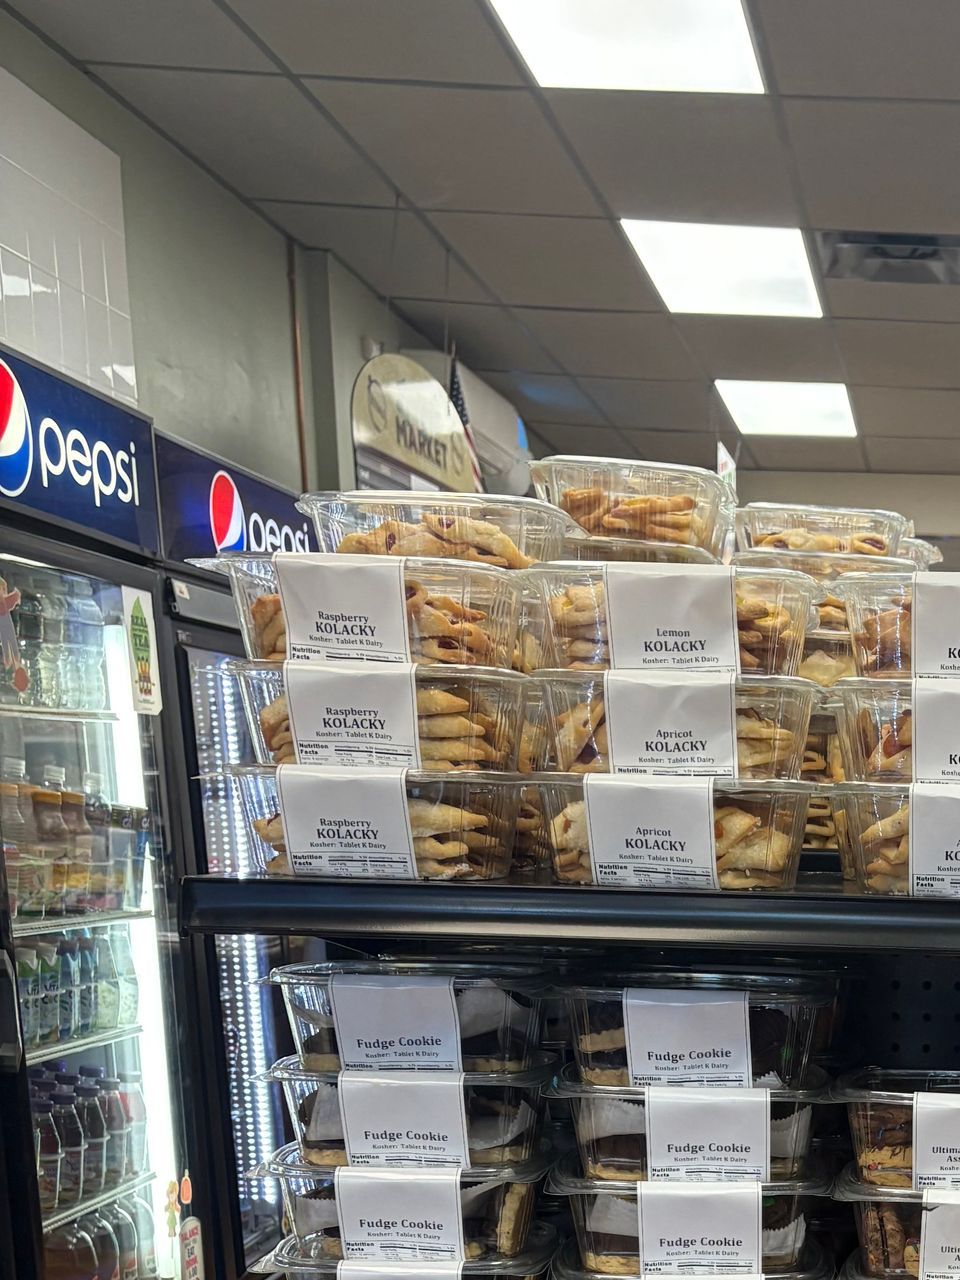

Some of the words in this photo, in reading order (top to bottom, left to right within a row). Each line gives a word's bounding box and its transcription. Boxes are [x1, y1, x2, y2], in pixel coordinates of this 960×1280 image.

[39, 418, 139, 507] pepsi
[249, 512, 309, 552] pepsi
[318, 611, 368, 624] Raspberry
[316, 622, 376, 636] KOLACKY
[657, 628, 690, 637] Lemon
[644, 640, 706, 652] KOLACKY
[326, 707, 378, 718] Raspberry
[323, 718, 385, 730] KOLACKY
[656, 730, 692, 740] Apricot
[646, 741, 706, 752] KOLACKY
[320, 818, 371, 829] Raspberry
[317, 828, 378, 839] KOLACKY
[636, 827, 671, 837] Apricot
[626, 839, 686, 851] KOLACKY
[357, 1039, 394, 1050] Fudge
[399, 1036, 441, 1046] Cookie
[648, 1052, 684, 1064] Fudge
[689, 1048, 731, 1059] Cookie
[364, 1130, 401, 1142] Fudge
[406, 1131, 448, 1141] Cookie
[668, 1144, 704, 1154] Fudge
[709, 1143, 750, 1152] Cookie
